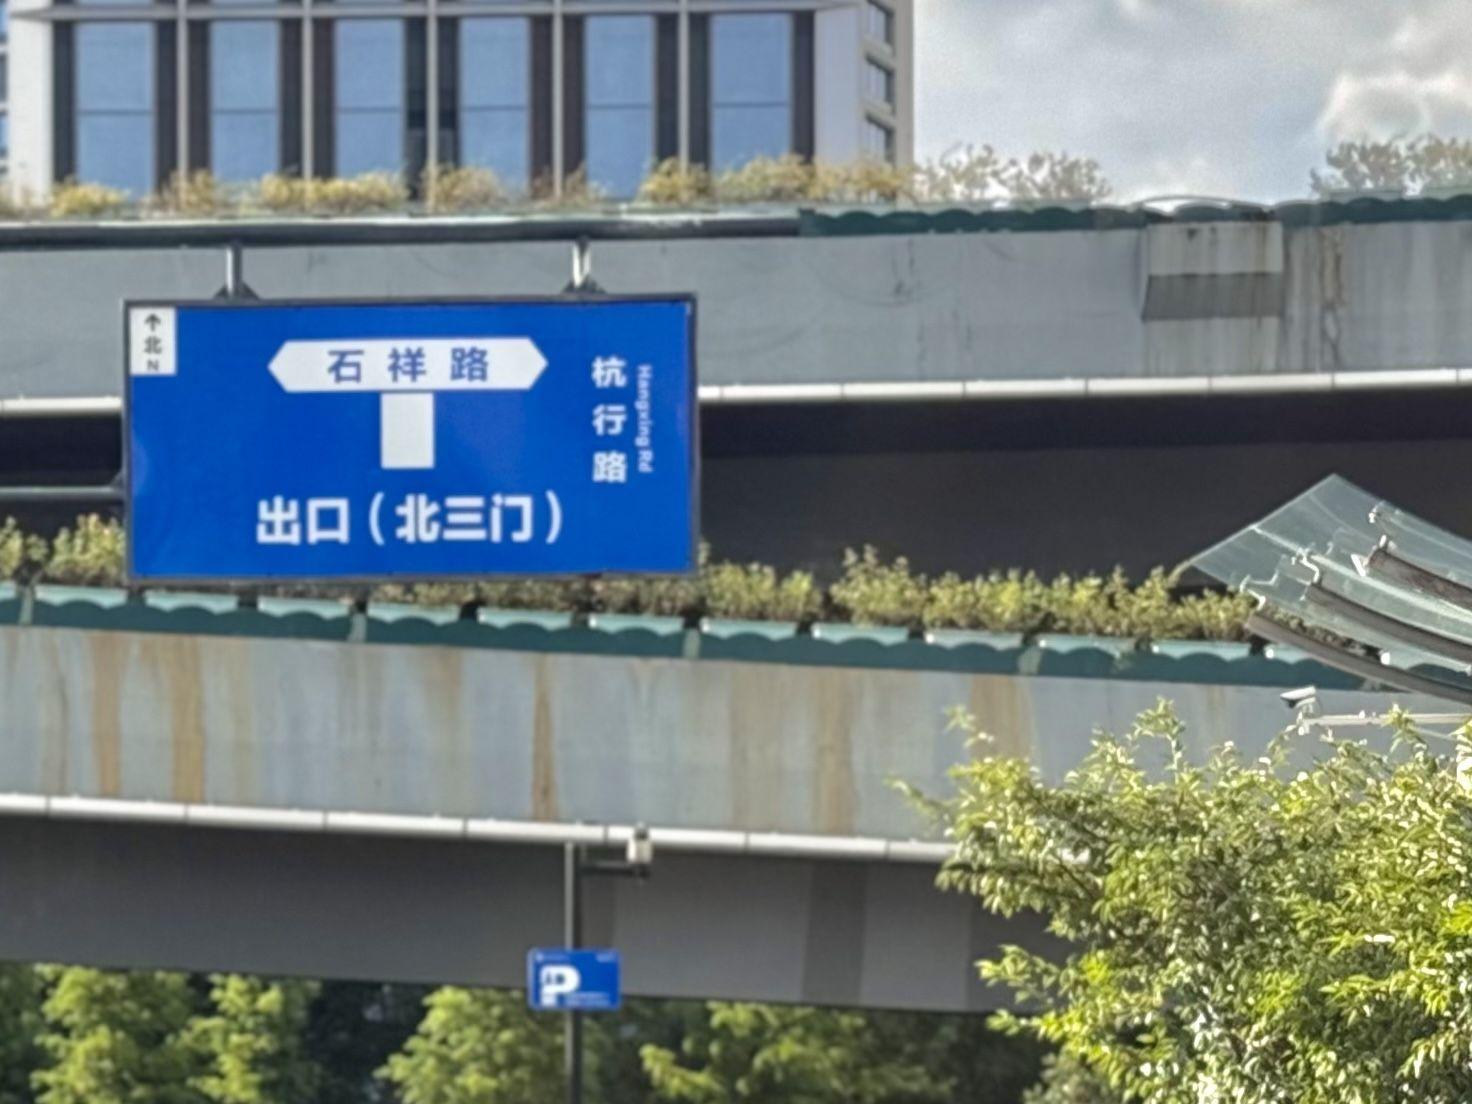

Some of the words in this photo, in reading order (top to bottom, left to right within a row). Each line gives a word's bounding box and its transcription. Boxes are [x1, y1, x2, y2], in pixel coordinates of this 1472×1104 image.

[144, 336, 162, 354] 北
[147, 359, 159, 372] N
[327, 347, 488, 383] 石祥路
[591, 355, 627, 482] 杭行路
[634, 364, 652, 447] Hangxing
[638, 450, 653, 472] Rd
[256, 490, 562, 546] 出口（北三门）
[540, 965, 580, 1006] P
